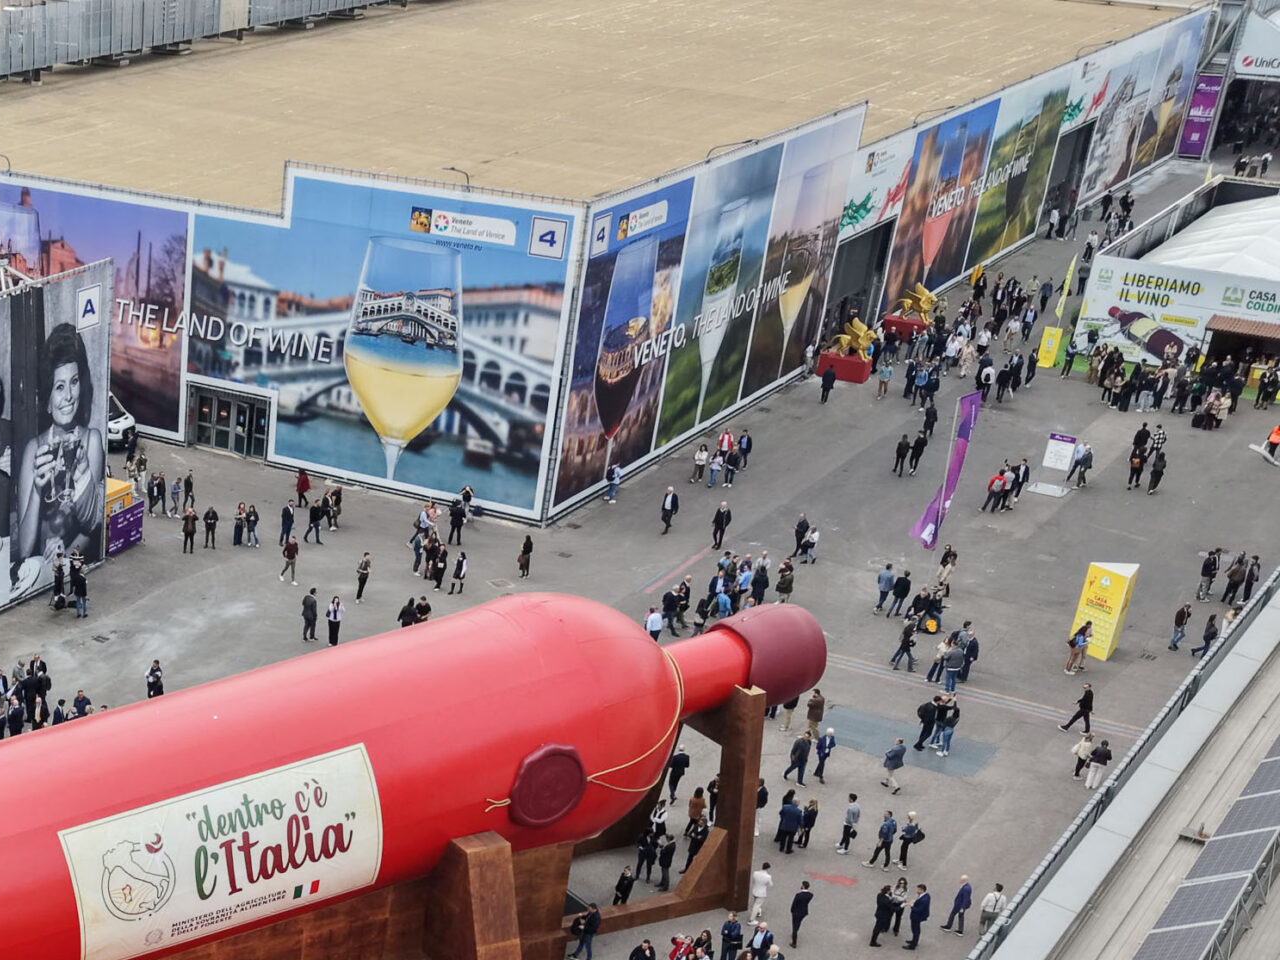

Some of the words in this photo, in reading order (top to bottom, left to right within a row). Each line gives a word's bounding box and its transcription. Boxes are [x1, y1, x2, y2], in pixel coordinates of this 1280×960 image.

[451, 216, 472, 226] Veneto
[538, 230, 557, 248] 4
[596, 225, 606, 243] 4
[1123, 272, 1201, 297] LIBERIAMO
[1119, 288, 1131, 303] IL
[1137, 290, 1170, 307] VINO
[1249, 290, 1277, 303] CASA
[81, 298, 96, 319] A
[634, 322, 687, 369] VENETO,
[692, 307, 714, 339] THE
[714, 293, 745, 328] LAND
[745, 284, 763, 311] OF
[762, 270, 792, 304] WINE
[116, 298, 159, 329] THE
[162, 308, 224, 342] LAND
[229, 322, 264, 348] OF
[267, 327, 334, 364] WINE
[171, 922, 194, 933] DELLA
[239, 894, 286, 912] ALIMENTARE
[172, 911, 213, 928] MINISTERO
[215, 889, 287, 915] DELL'AGRICOLTURA
[177, 926, 199, 936] DELLE
[200, 915, 232, 929] FORESTE
